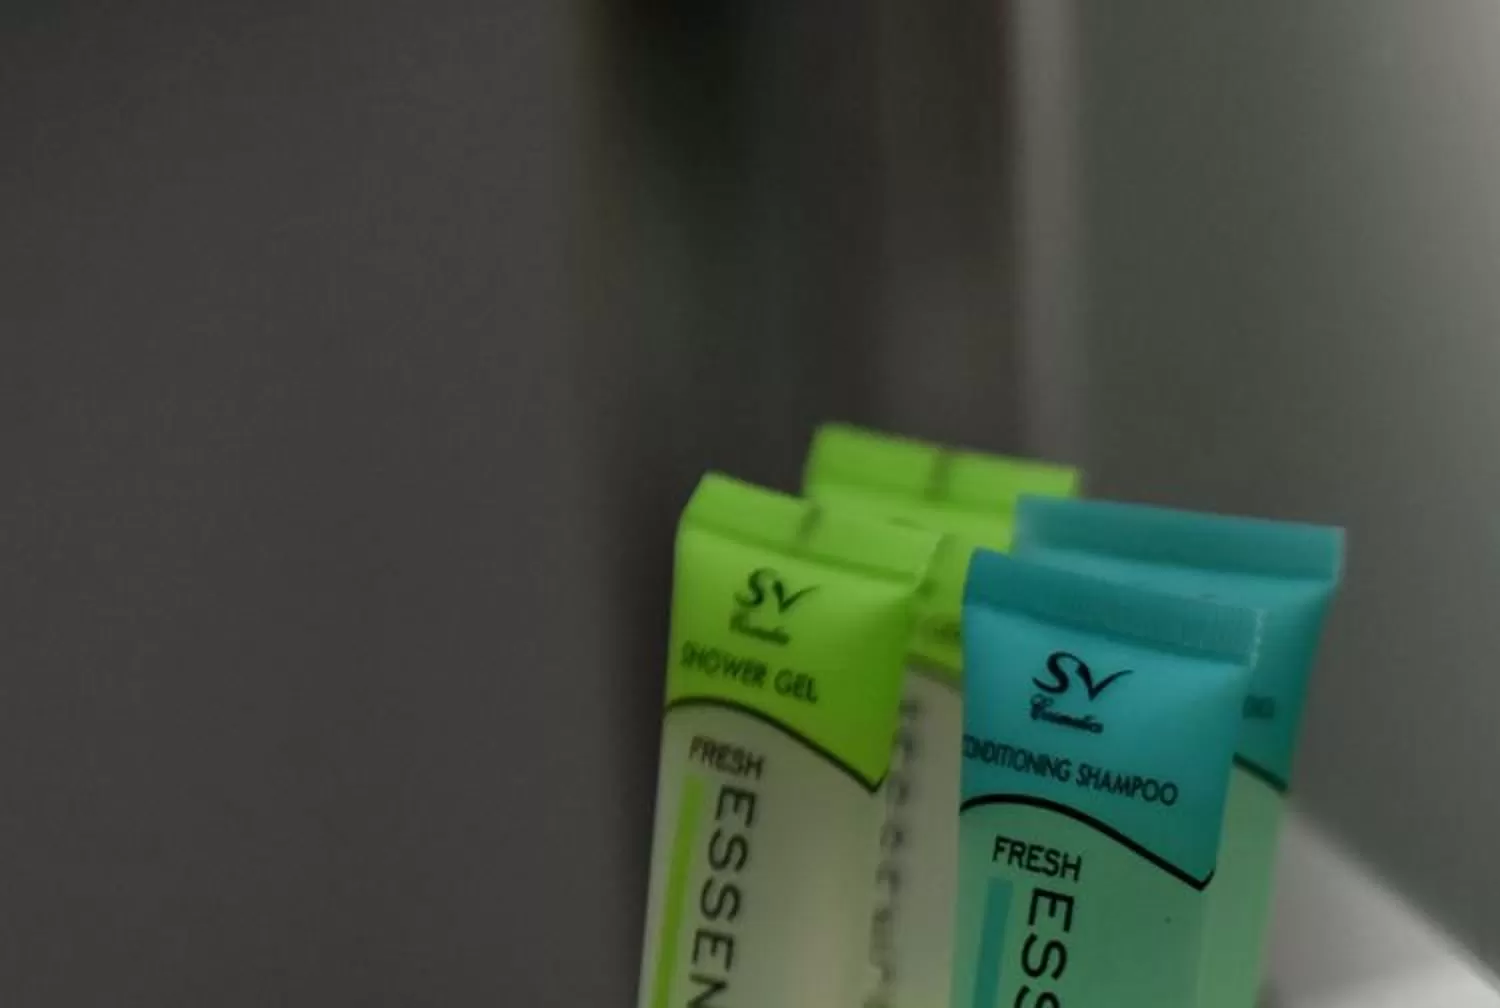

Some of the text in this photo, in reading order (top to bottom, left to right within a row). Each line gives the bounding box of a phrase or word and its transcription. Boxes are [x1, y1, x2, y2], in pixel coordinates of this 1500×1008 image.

[733, 567, 821, 614] SV
[680, 638, 819, 704] SHOWER GEL
[1031, 650, 1134, 701] SV
[690, 735, 765, 782] FRESH
[1075, 762, 1179, 807] SHAMPOO
[991, 834, 1083, 884] FRESH
